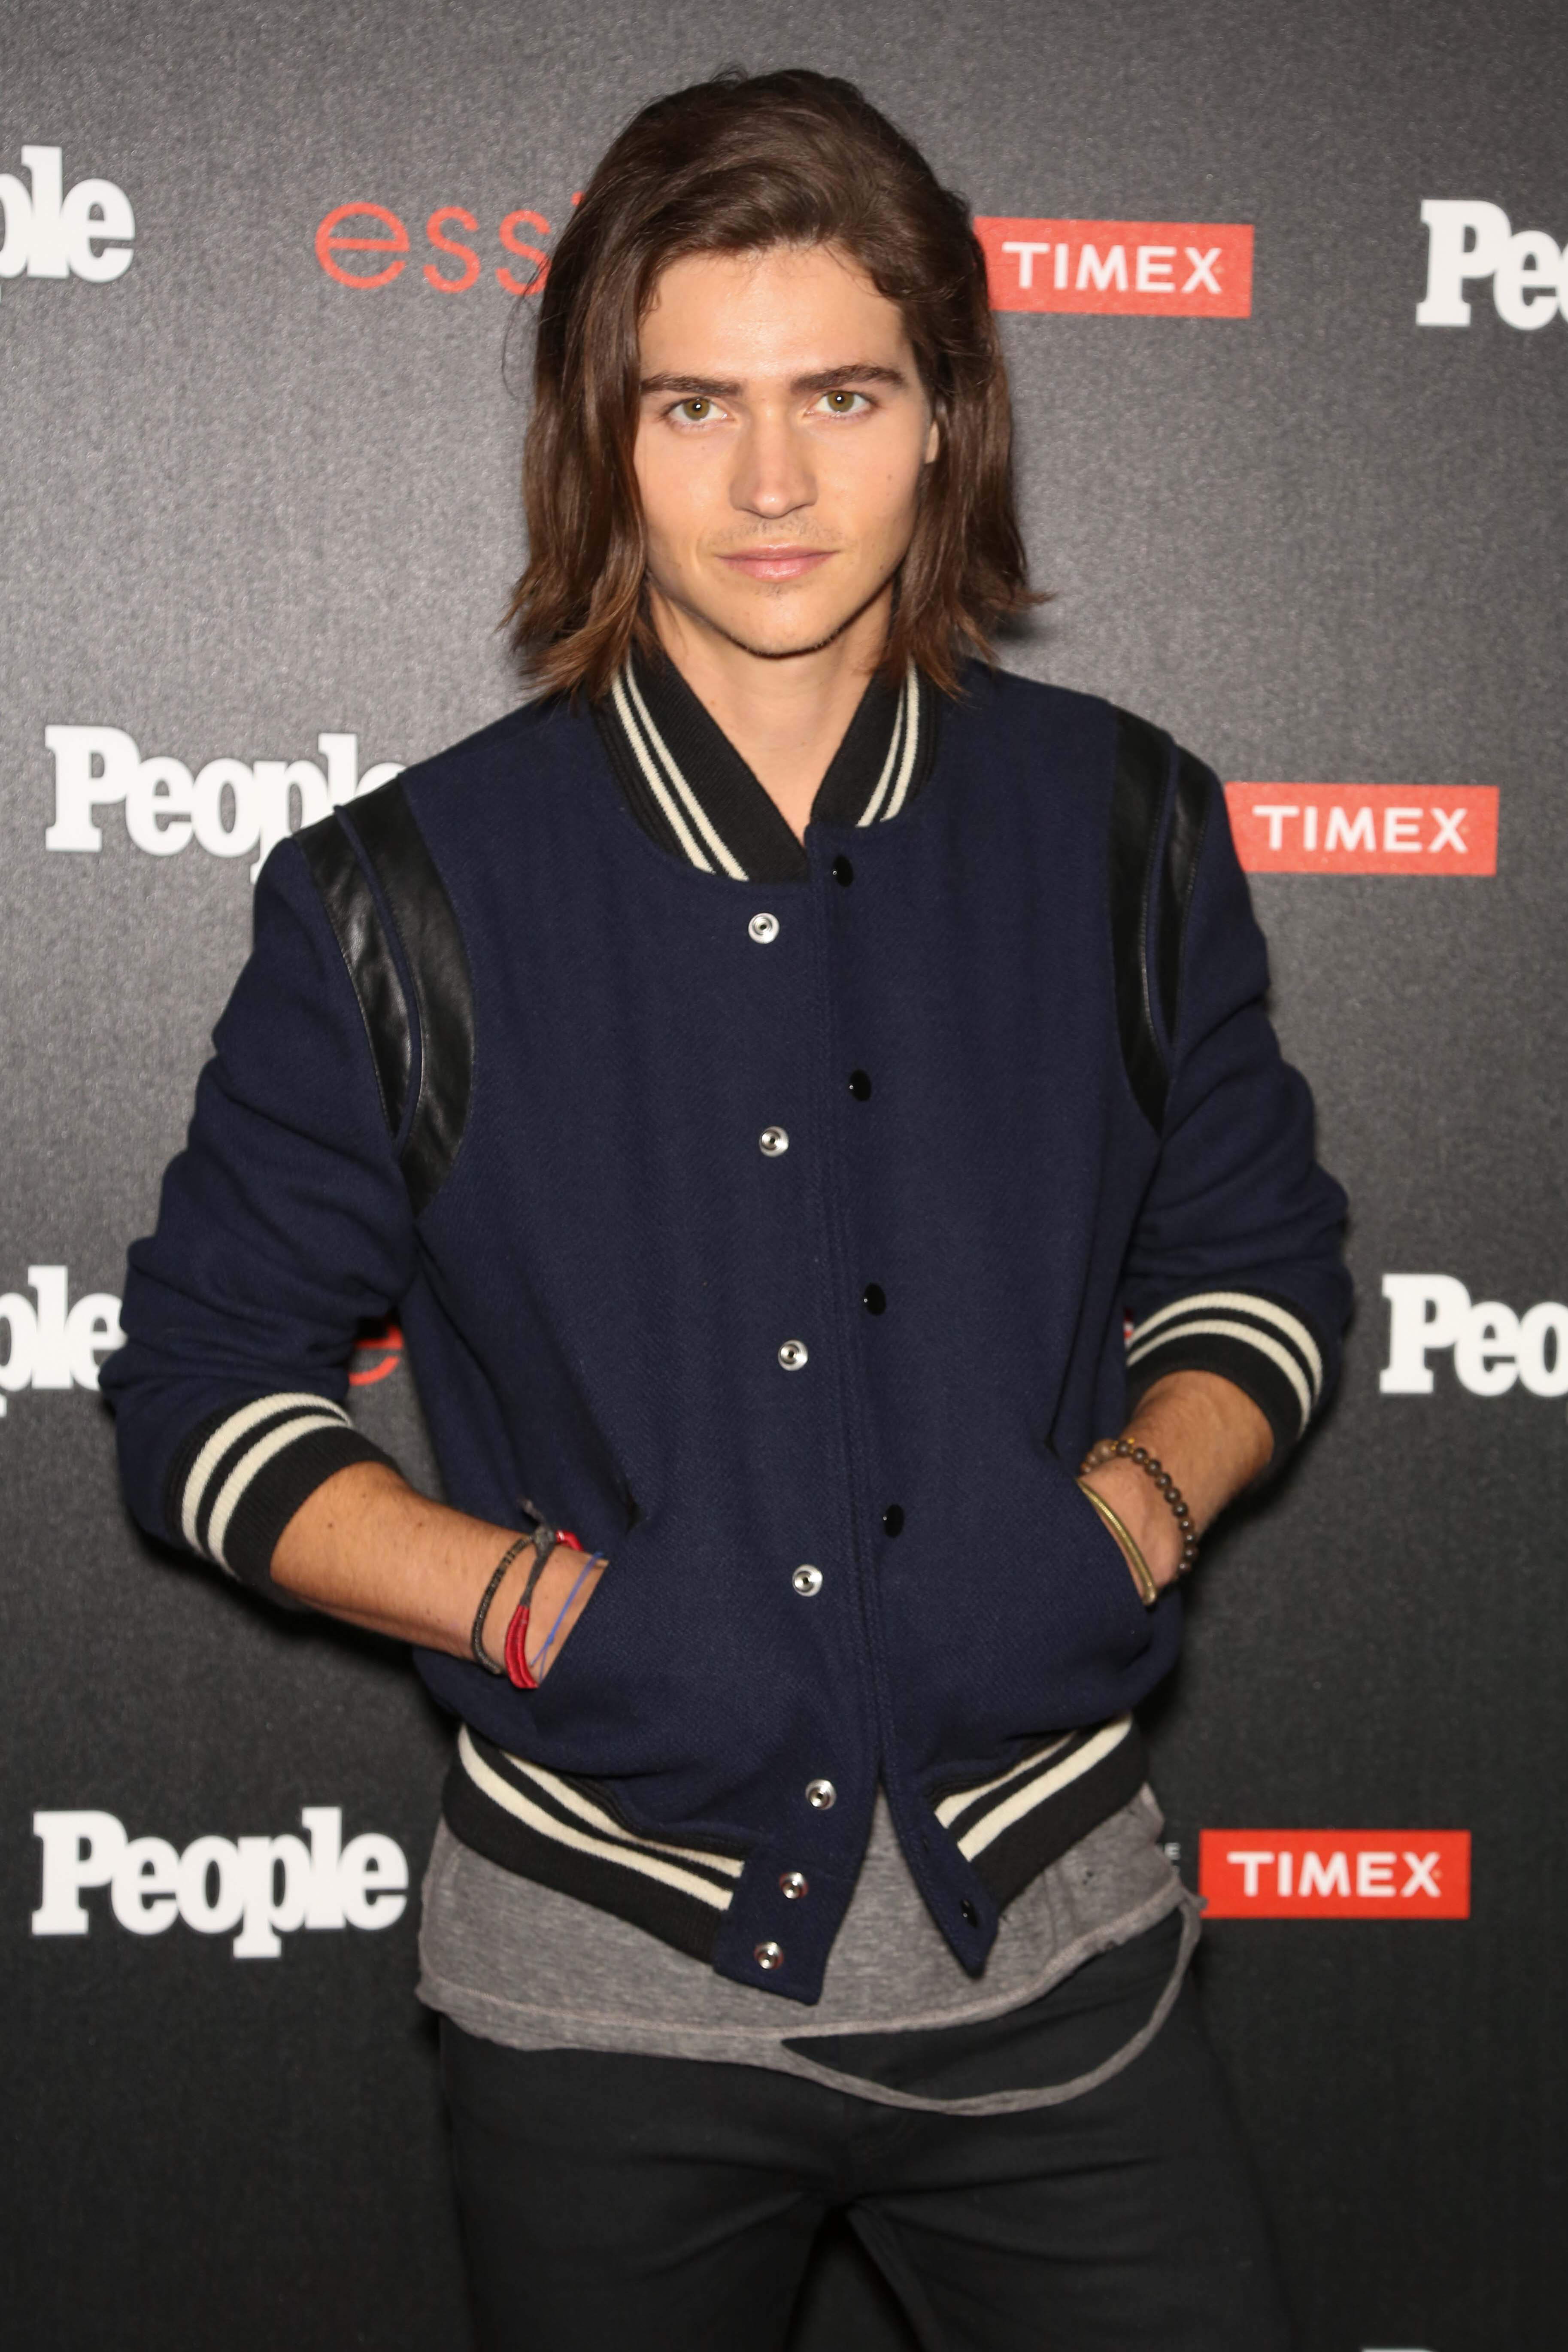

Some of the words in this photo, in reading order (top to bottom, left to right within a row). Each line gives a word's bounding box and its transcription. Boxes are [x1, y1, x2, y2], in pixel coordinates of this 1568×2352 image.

[314, 191, 585, 296] ess
[1001, 240, 1222, 295] TIMEX
[1416, 199, 1568, 330] Pe
[44, 725, 407, 883] Peopl
[1251, 804, 1468, 854] TIMEX
[1380, 1274, 1568, 1397] Peo
[32, 1807, 408, 1958] People
[1226, 1851, 1441, 1897] TIMEX
